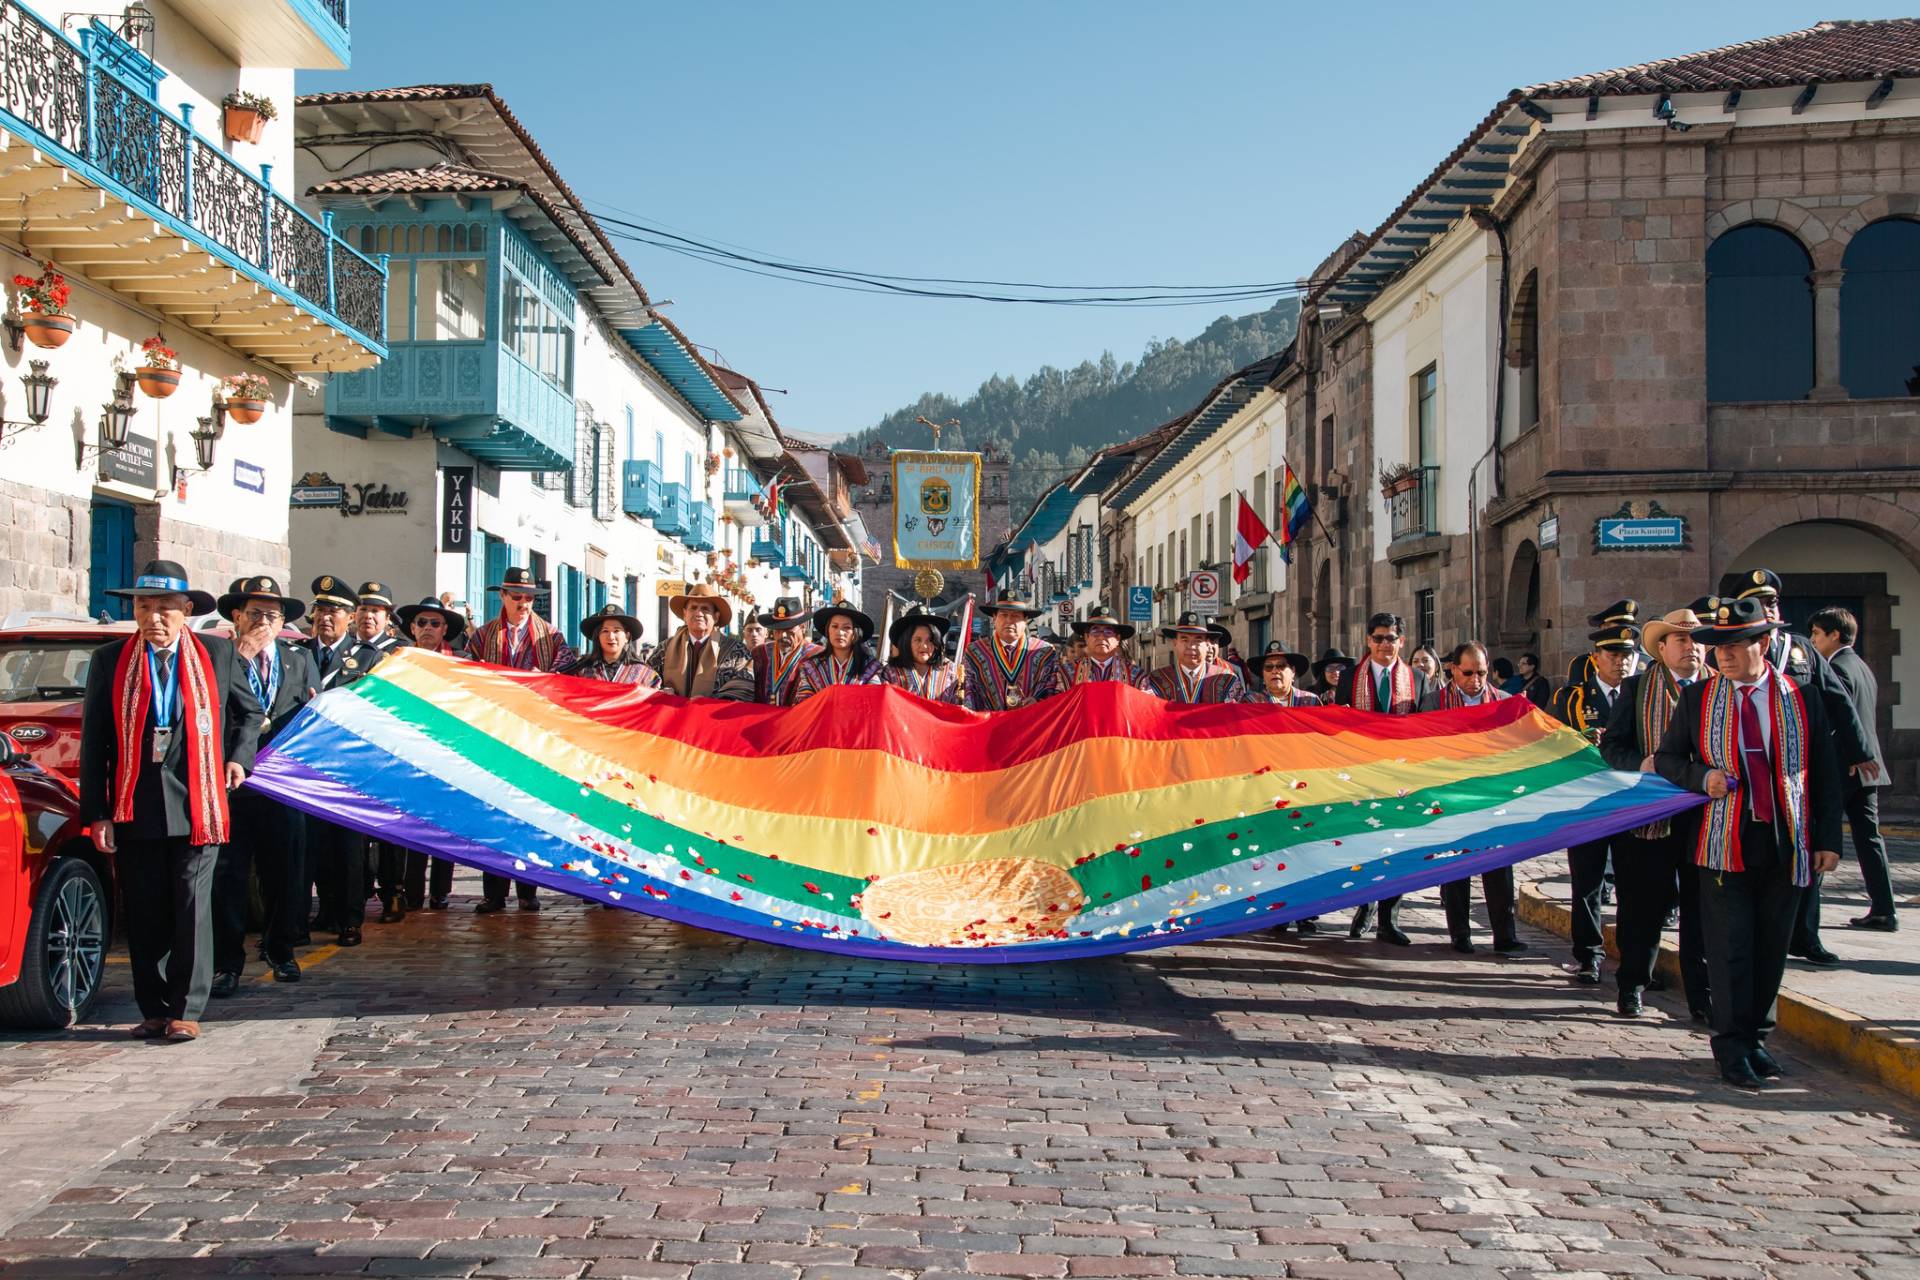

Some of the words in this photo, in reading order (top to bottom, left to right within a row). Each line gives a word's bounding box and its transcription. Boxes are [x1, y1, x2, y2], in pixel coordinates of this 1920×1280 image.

[128, 442, 152, 458] FACTORY
[119, 451, 141, 466] OUTLET
[348, 483, 408, 515] Yaku
[451, 475, 465, 543] YAKU
[1640, 527, 1674, 536] Kusipata
[1199, 578, 1210, 594] E
